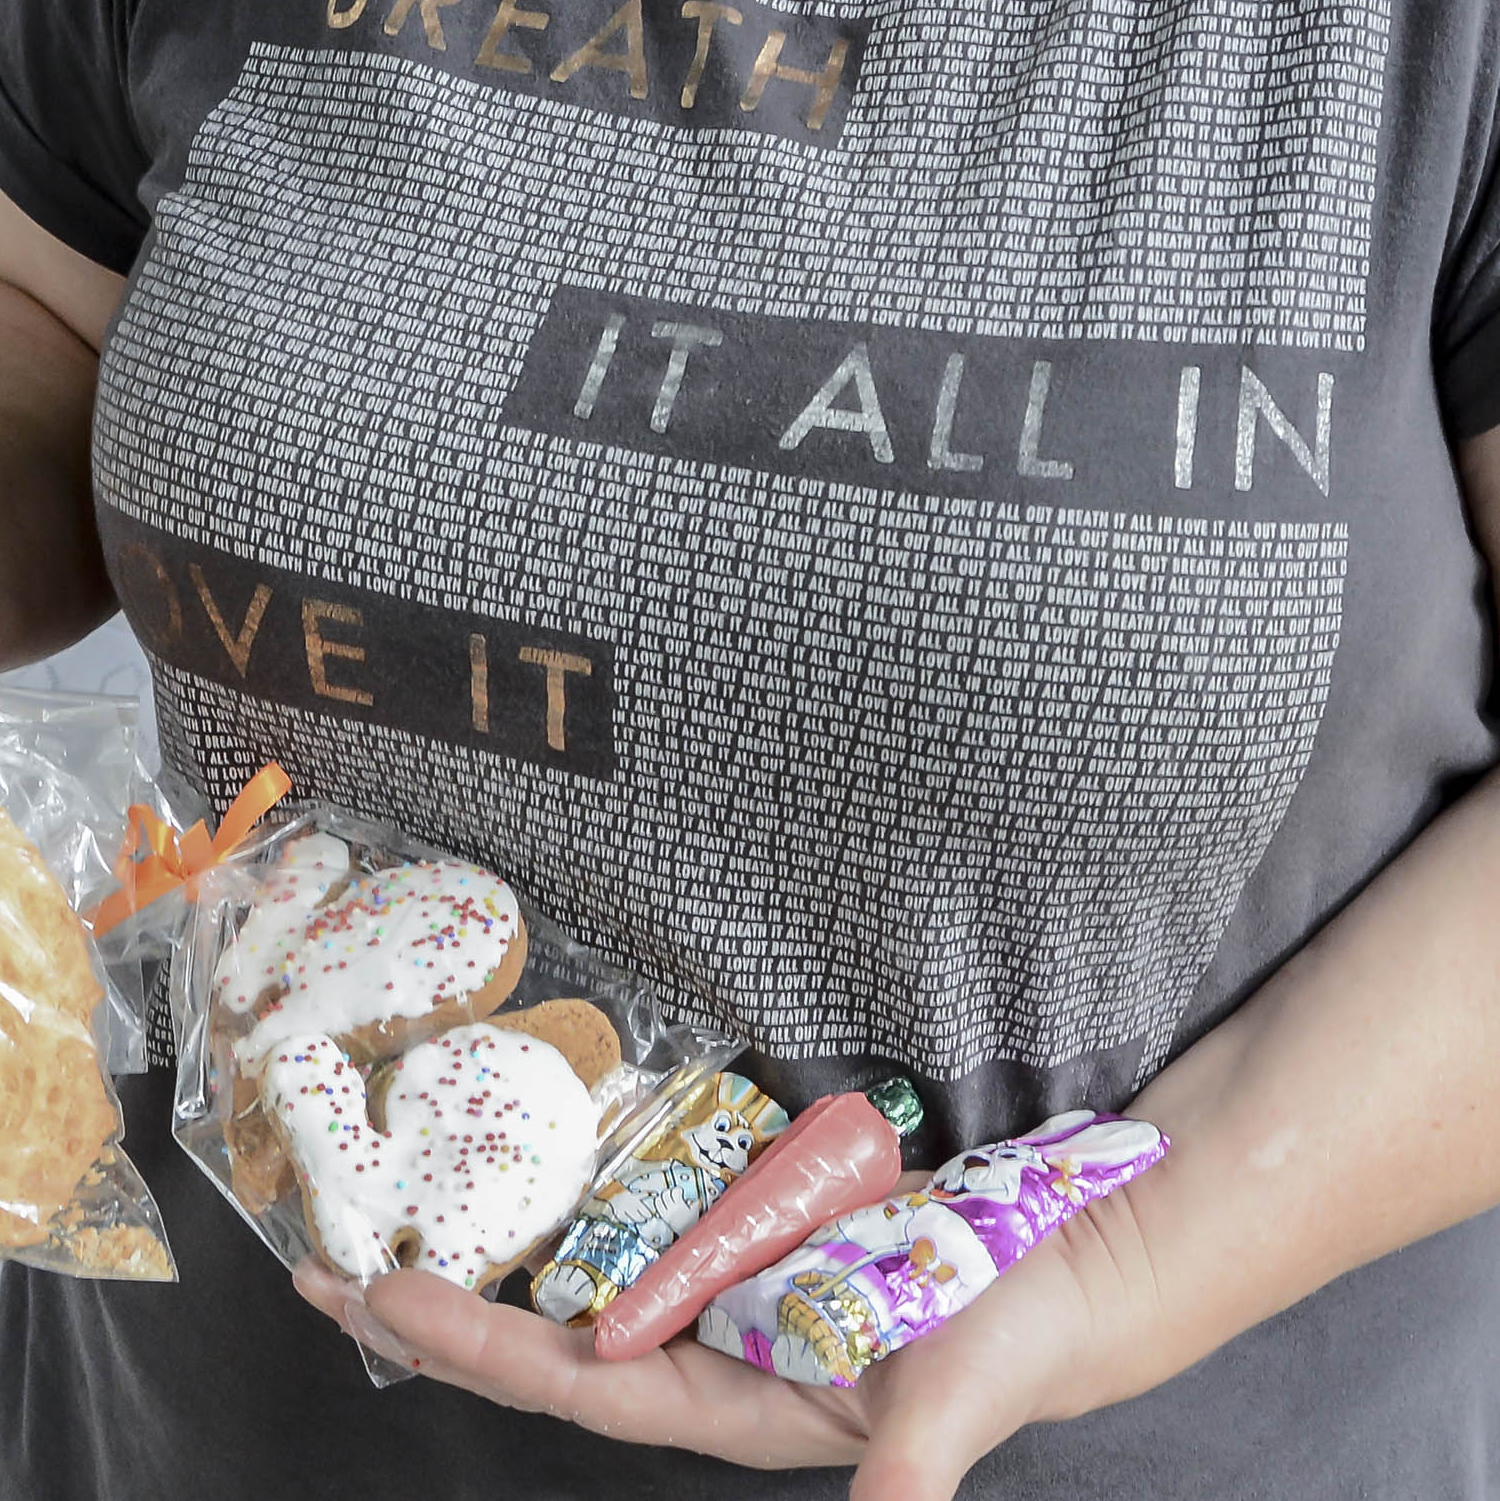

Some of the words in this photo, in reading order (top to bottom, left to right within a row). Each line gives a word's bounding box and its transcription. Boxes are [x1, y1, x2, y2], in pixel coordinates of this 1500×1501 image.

[573, 312, 724, 435] IT
[777, 341, 1075, 481] ALL
[1173, 364, 1336, 498] IN
[534, 433, 548, 449] IT
[550, 436, 571, 455] ALL
[577, 442, 603, 459] OUT
[606, 445, 654, 469] BREATH
[658, 457, 672, 472] IT
[674, 459, 696, 477] ALL
[701, 463, 716, 479] IN
[721, 465, 752, 485] LOVE
[756, 471, 769, 488] IT
[772, 474, 796, 492] ALL
[799, 477, 825, 497] OUT
[829, 483, 877, 505] BREATH
[882, 490, 895, 507] IT
[898, 489, 919, 511] ALL
[925, 496, 940, 513] IN
[944, 498, 977, 517] LOVE
[980, 501, 994, 518] IT
[997, 502, 1019, 521] ALL
[1026, 505, 1053, 523] OUT
[1058, 508, 1108, 528] BREATH
[1114, 513, 1126, 529] IT
[1130, 514, 1152, 531] ALL
[1158, 516, 1172, 533] IN
[1177, 518, 1207, 536] LOVE
[1214, 520, 1225, 537] IT
[1228, 521, 1249, 538] ALL
[1254, 522, 1276, 539] OUT
[1281, 523, 1319, 540] BREATH
[1322, 523, 1332, 539] IT
[1334, 523, 1348, 539] ALL
[469, 632, 593, 752] IT
